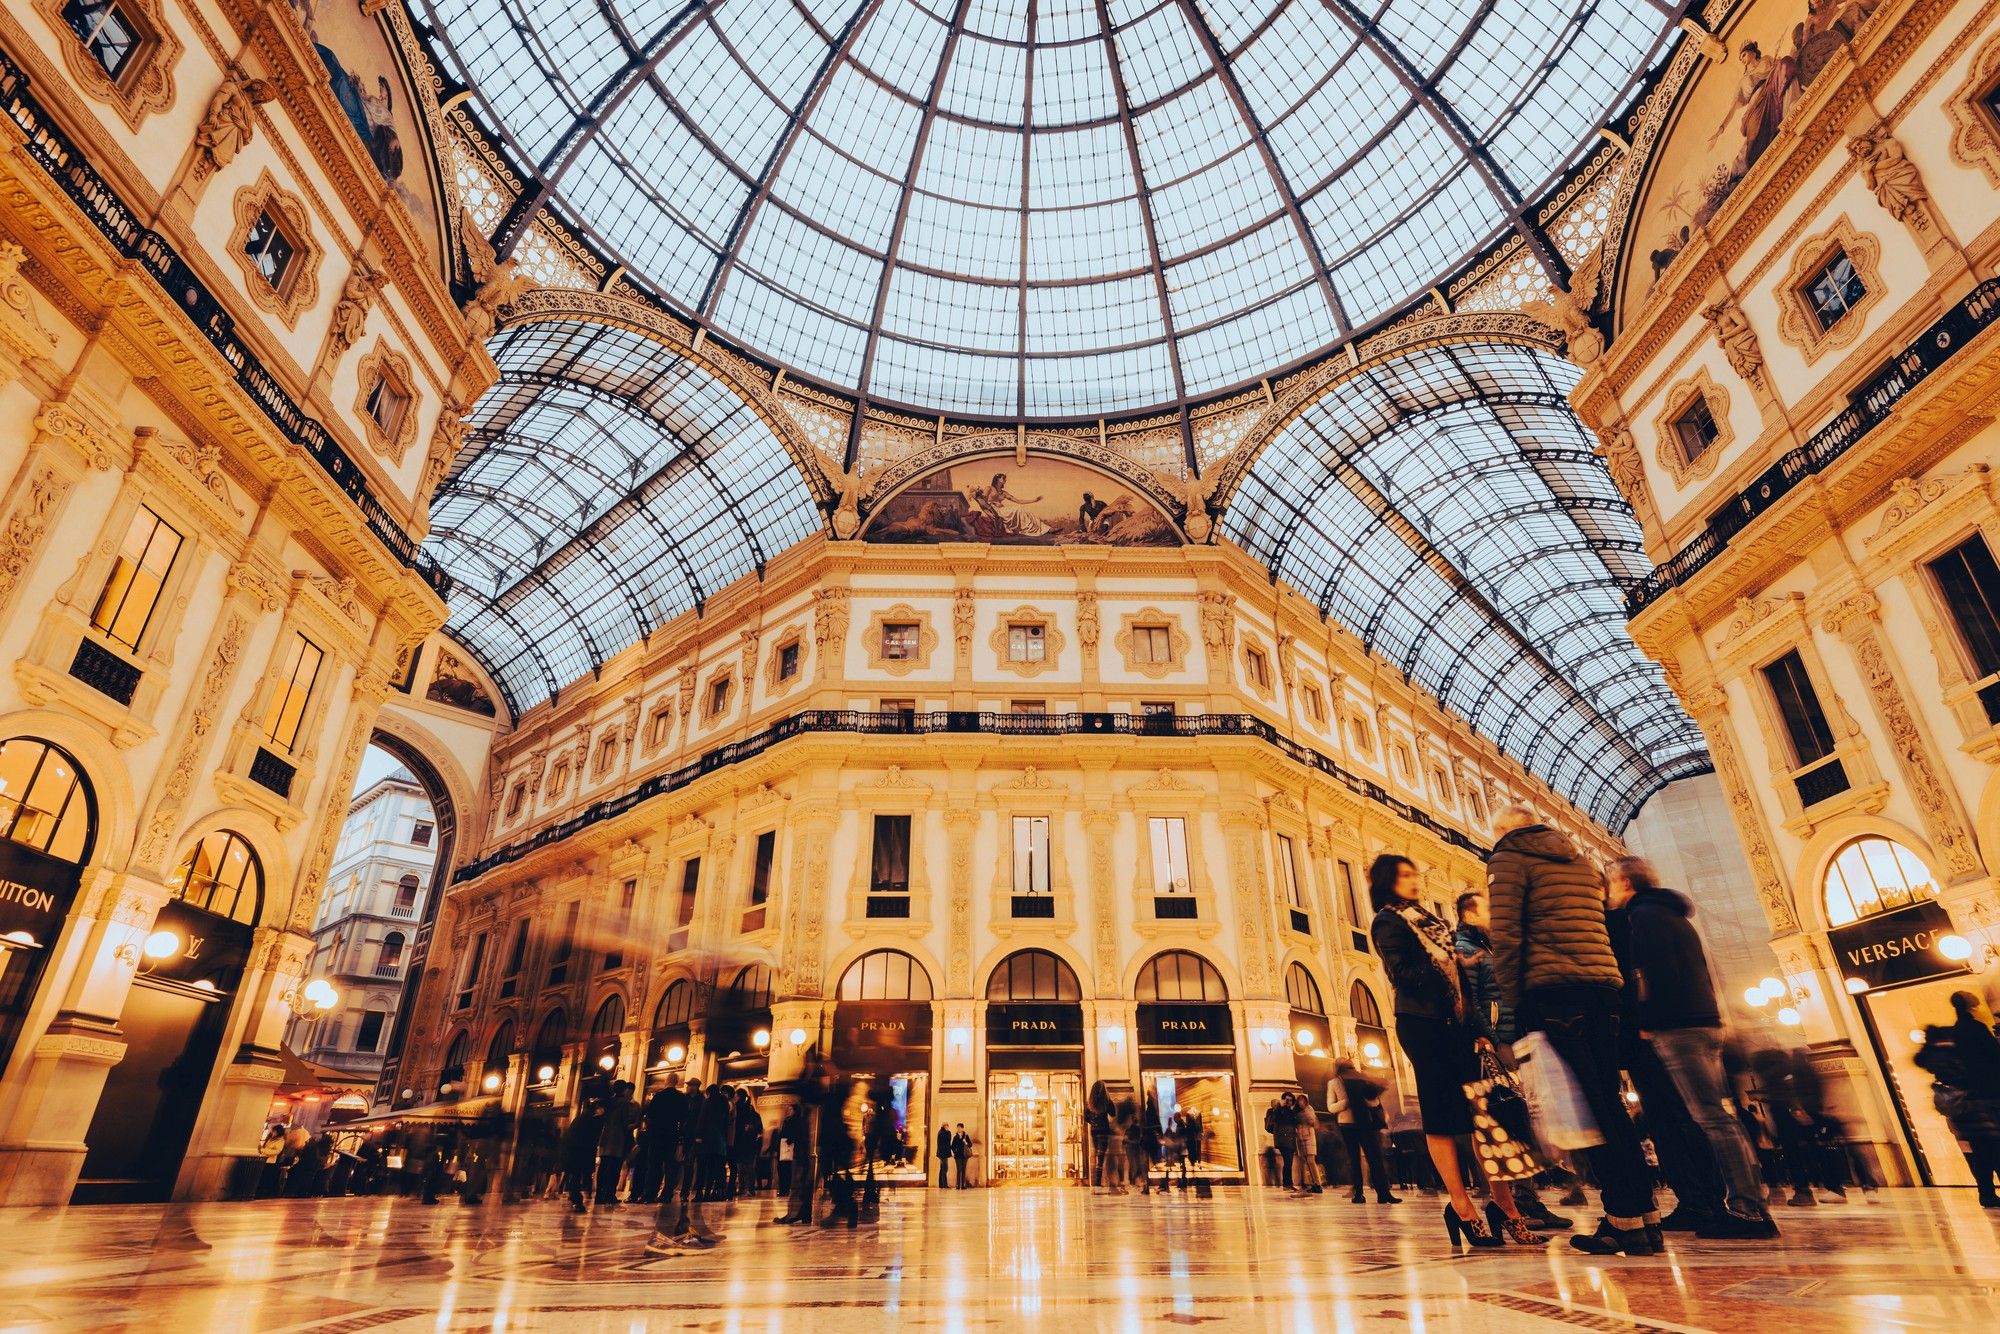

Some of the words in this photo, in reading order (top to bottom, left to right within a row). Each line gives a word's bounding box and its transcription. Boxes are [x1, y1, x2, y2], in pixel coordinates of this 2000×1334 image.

[861, 1021, 906, 1031] PRADA
[1012, 1021, 1057, 1030] PRADA
[1162, 1021, 1207, 1030] PRADA
[443, 1108, 480, 1117] RISTORANTE
